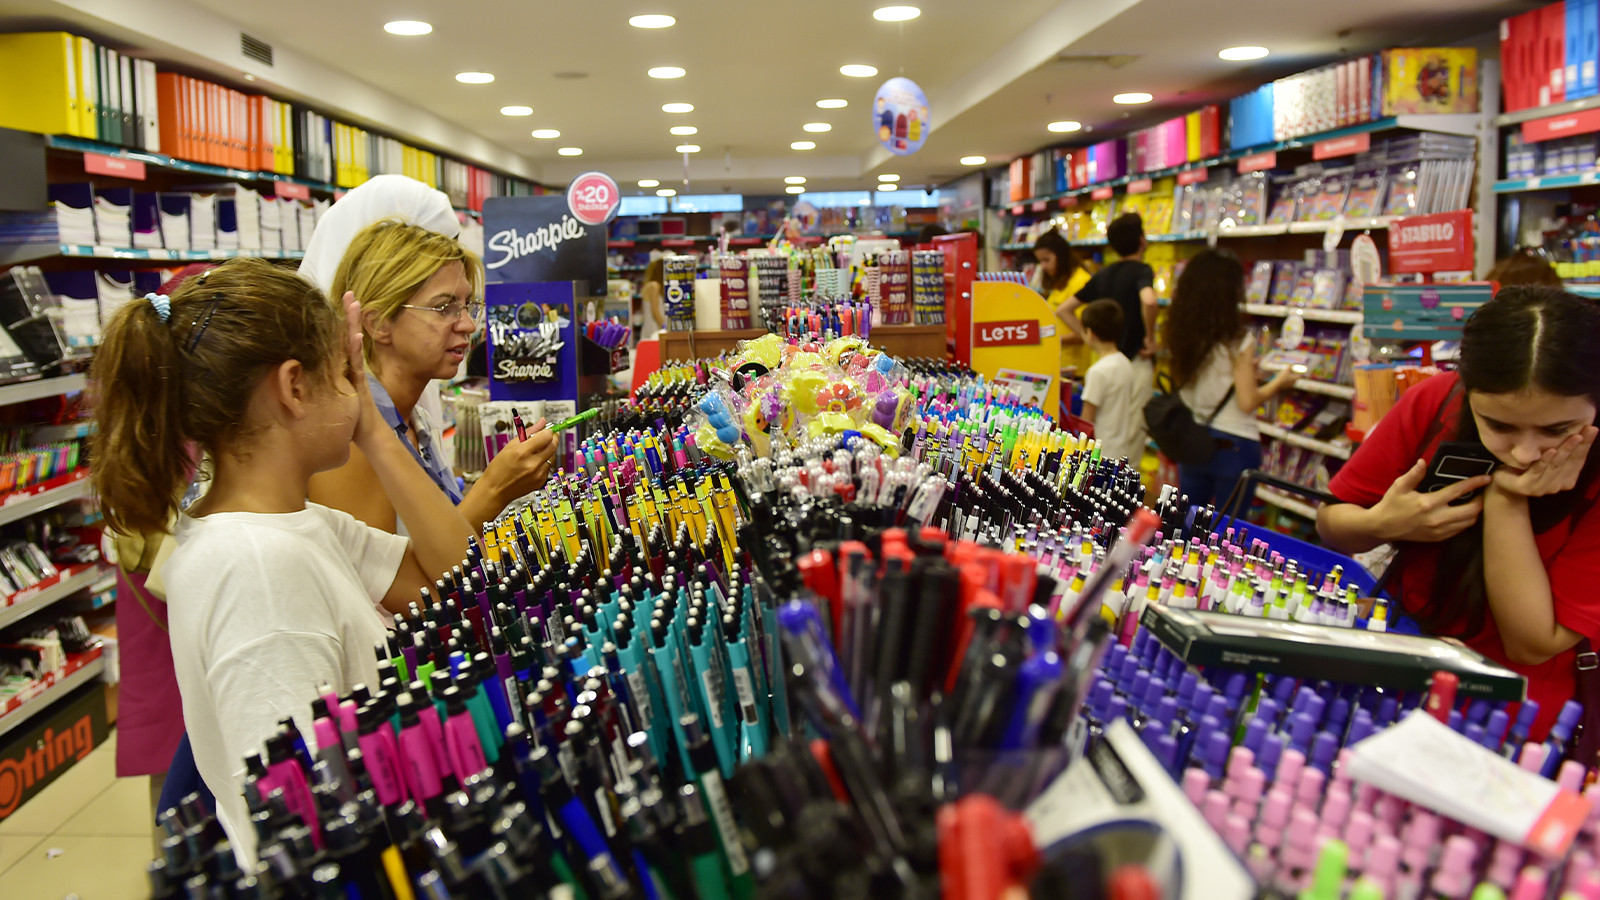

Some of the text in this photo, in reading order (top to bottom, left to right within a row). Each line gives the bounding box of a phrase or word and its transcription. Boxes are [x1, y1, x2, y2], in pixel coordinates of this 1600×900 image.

[486, 214, 584, 269] Sharpie
[1401, 222, 1455, 244] STABILO
[494, 359, 553, 380] Sharpie
